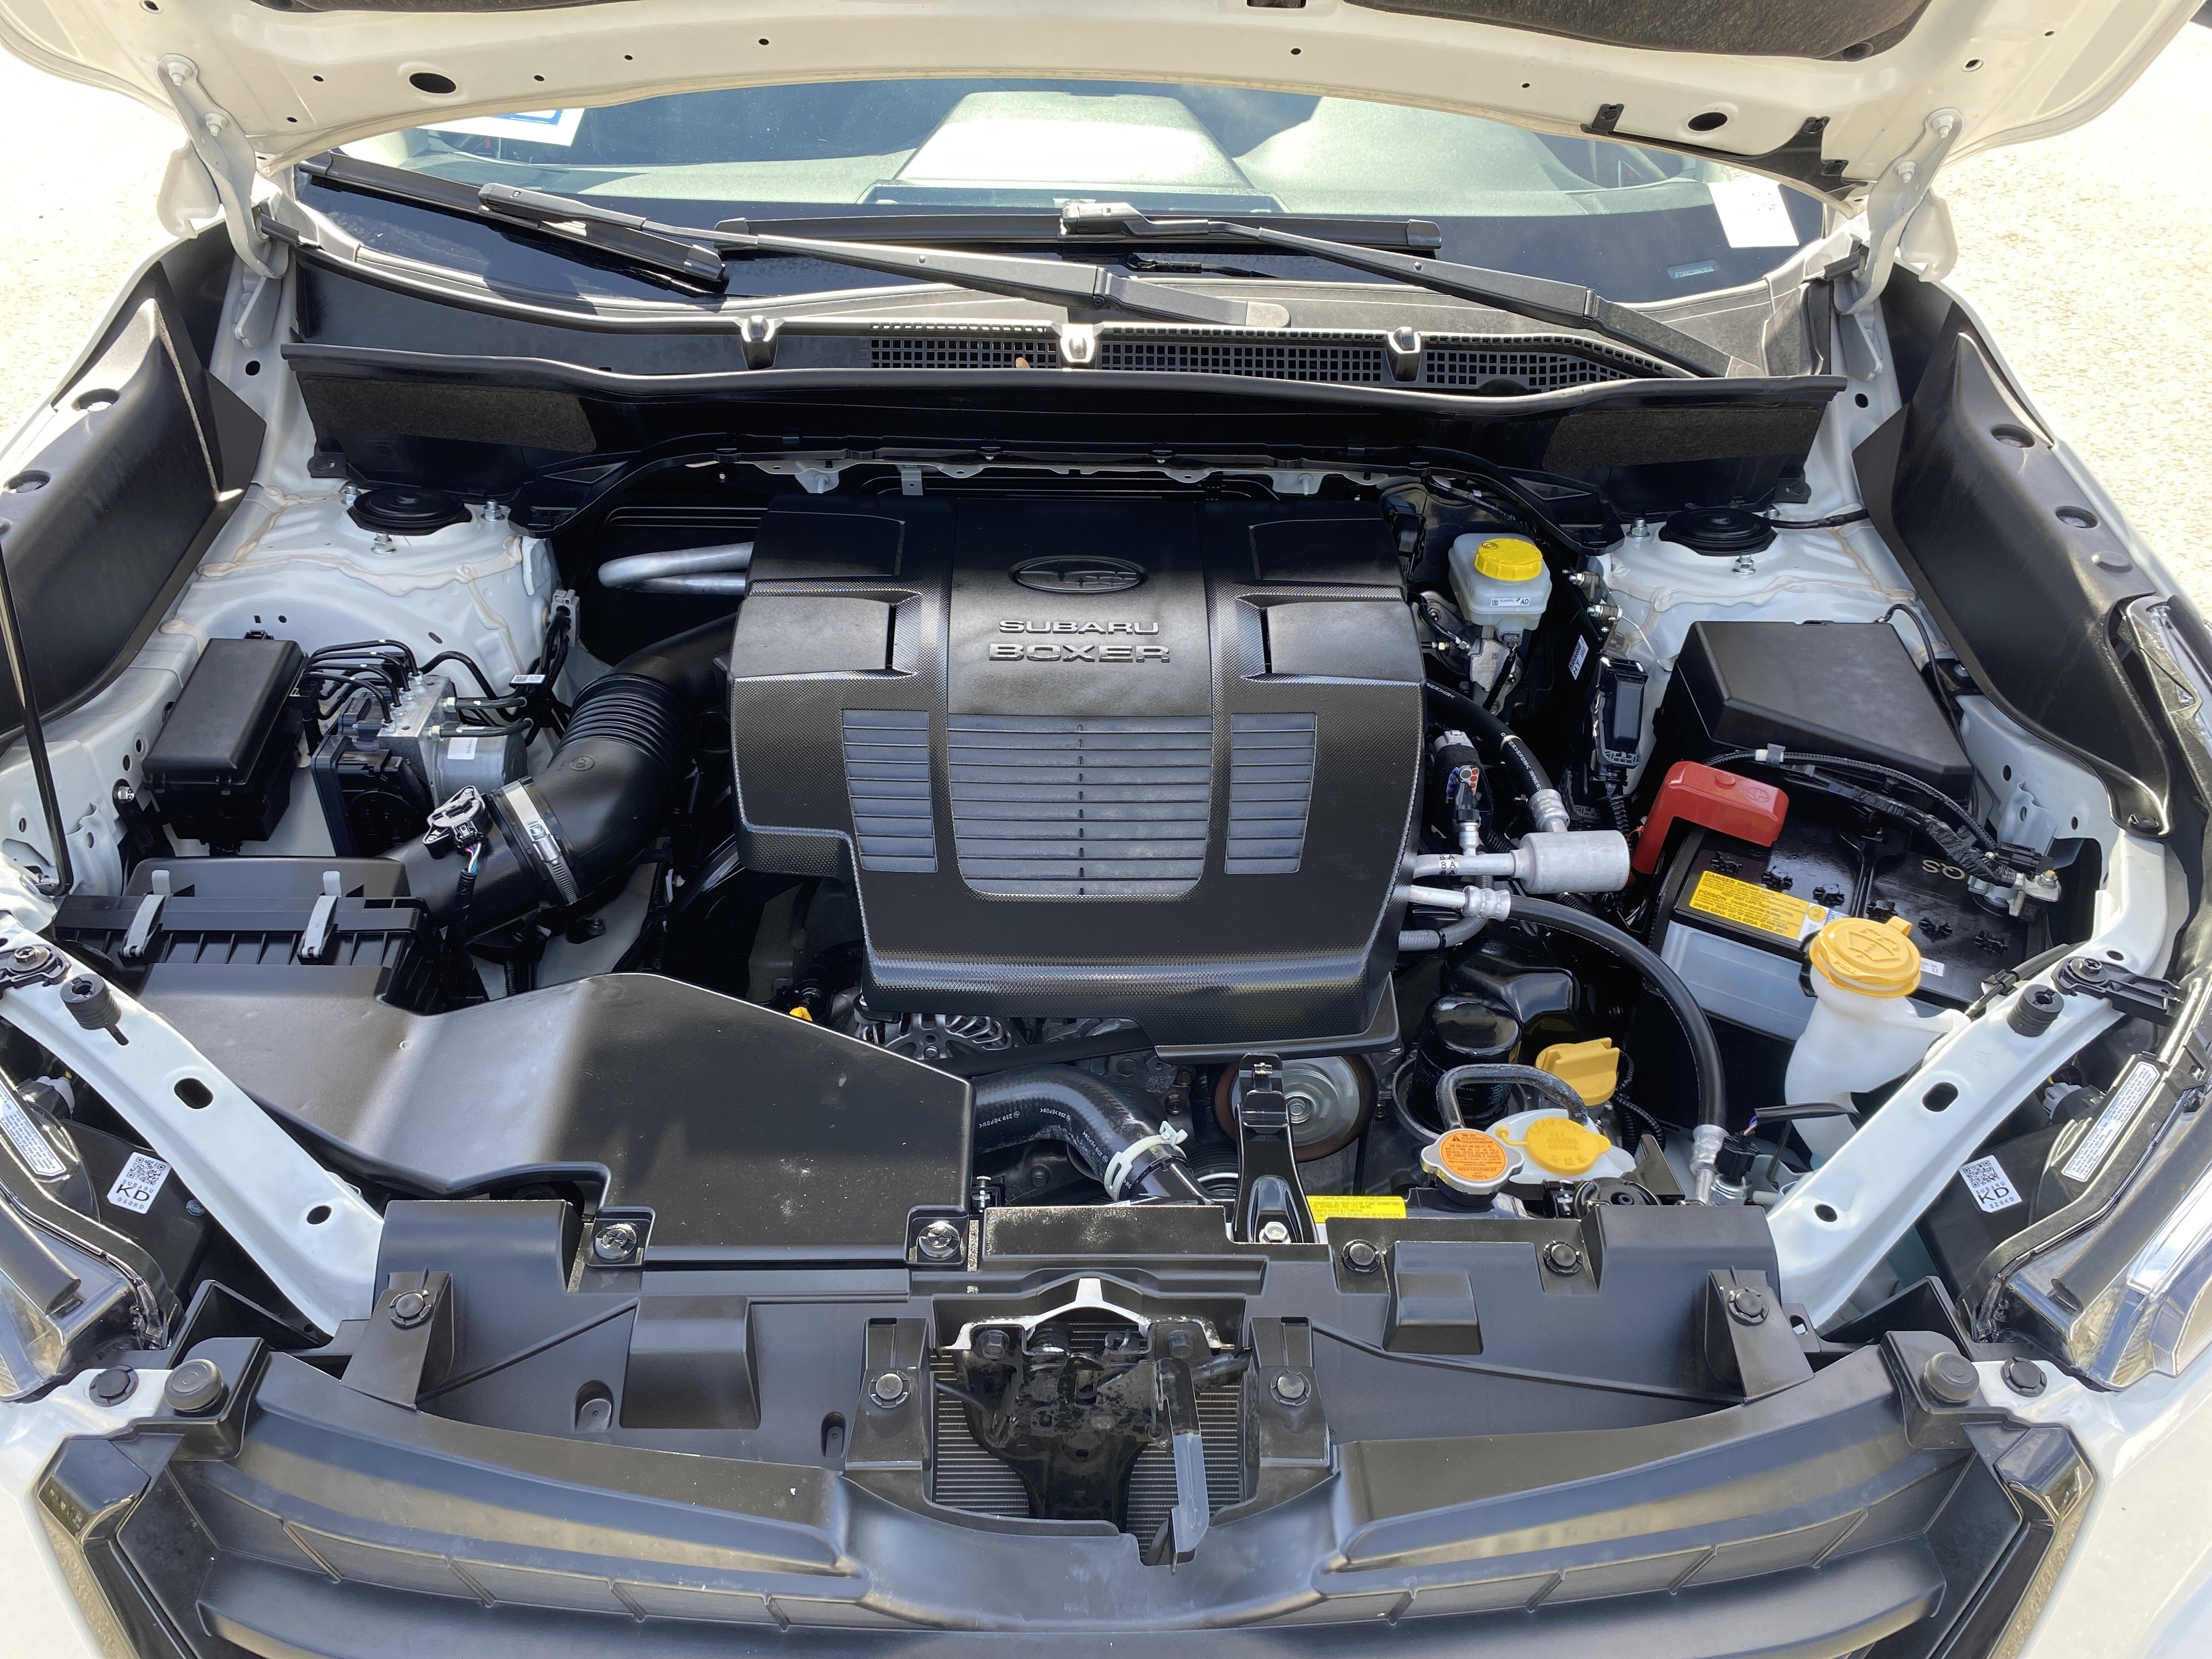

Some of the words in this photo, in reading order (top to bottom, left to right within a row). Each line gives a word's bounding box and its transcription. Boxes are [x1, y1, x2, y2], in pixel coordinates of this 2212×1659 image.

[999, 620, 1159, 635] SUBARU
[989, 644, 1170, 663] BOXER
[1705, 872, 1735, 884] DANGER
[1697, 889, 1728, 901] POISON
[1694, 902, 1709, 911] 20HR
[116, 1183, 150, 1201] KD
[122, 1179, 154, 1193] SUBARU
[1976, 1181, 2005, 1195] SUBARU
[1978, 1187, 2010, 1204] KD
